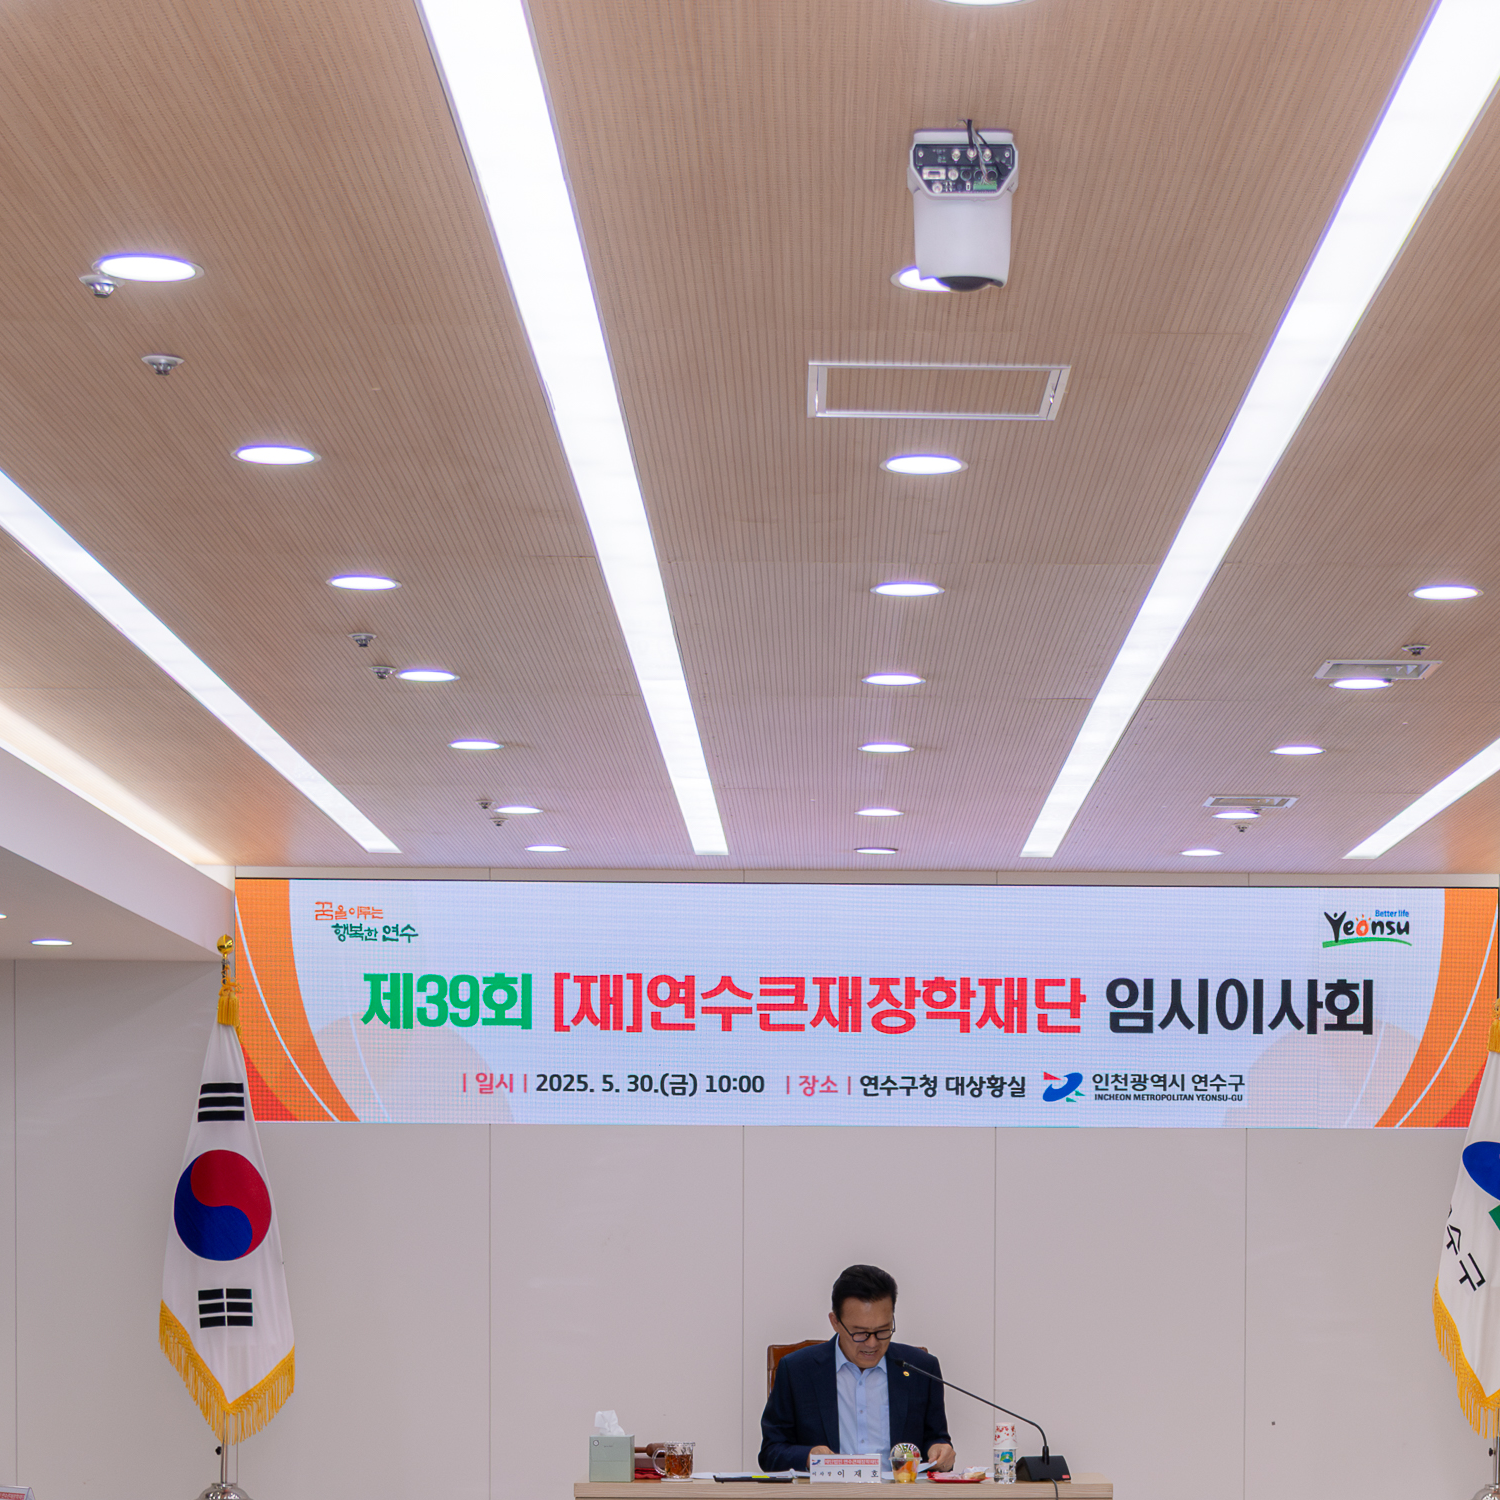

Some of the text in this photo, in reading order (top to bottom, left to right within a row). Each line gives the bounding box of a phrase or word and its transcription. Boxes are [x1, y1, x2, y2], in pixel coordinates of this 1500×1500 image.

[1375, 909, 1410, 918] Better life
[331, 923, 419, 943] 행복한 연수
[1324, 910, 1410, 943] Yeonsu
[361, 972, 1375, 1036] 제39회 [재]연수큰재장학재단 임시이사회
[475, 1072, 765, 1098] 일시 2025. 5. 30.(금) 10:00
[798, 1074, 1026, 1098] 장소 연수구청 대상황실
[1092, 1073, 1246, 1092] 인천광역시 연수구
[1195, 1094, 1244, 1102] YEONSU-GU
[1445, 1203, 1487, 1292] 수구
